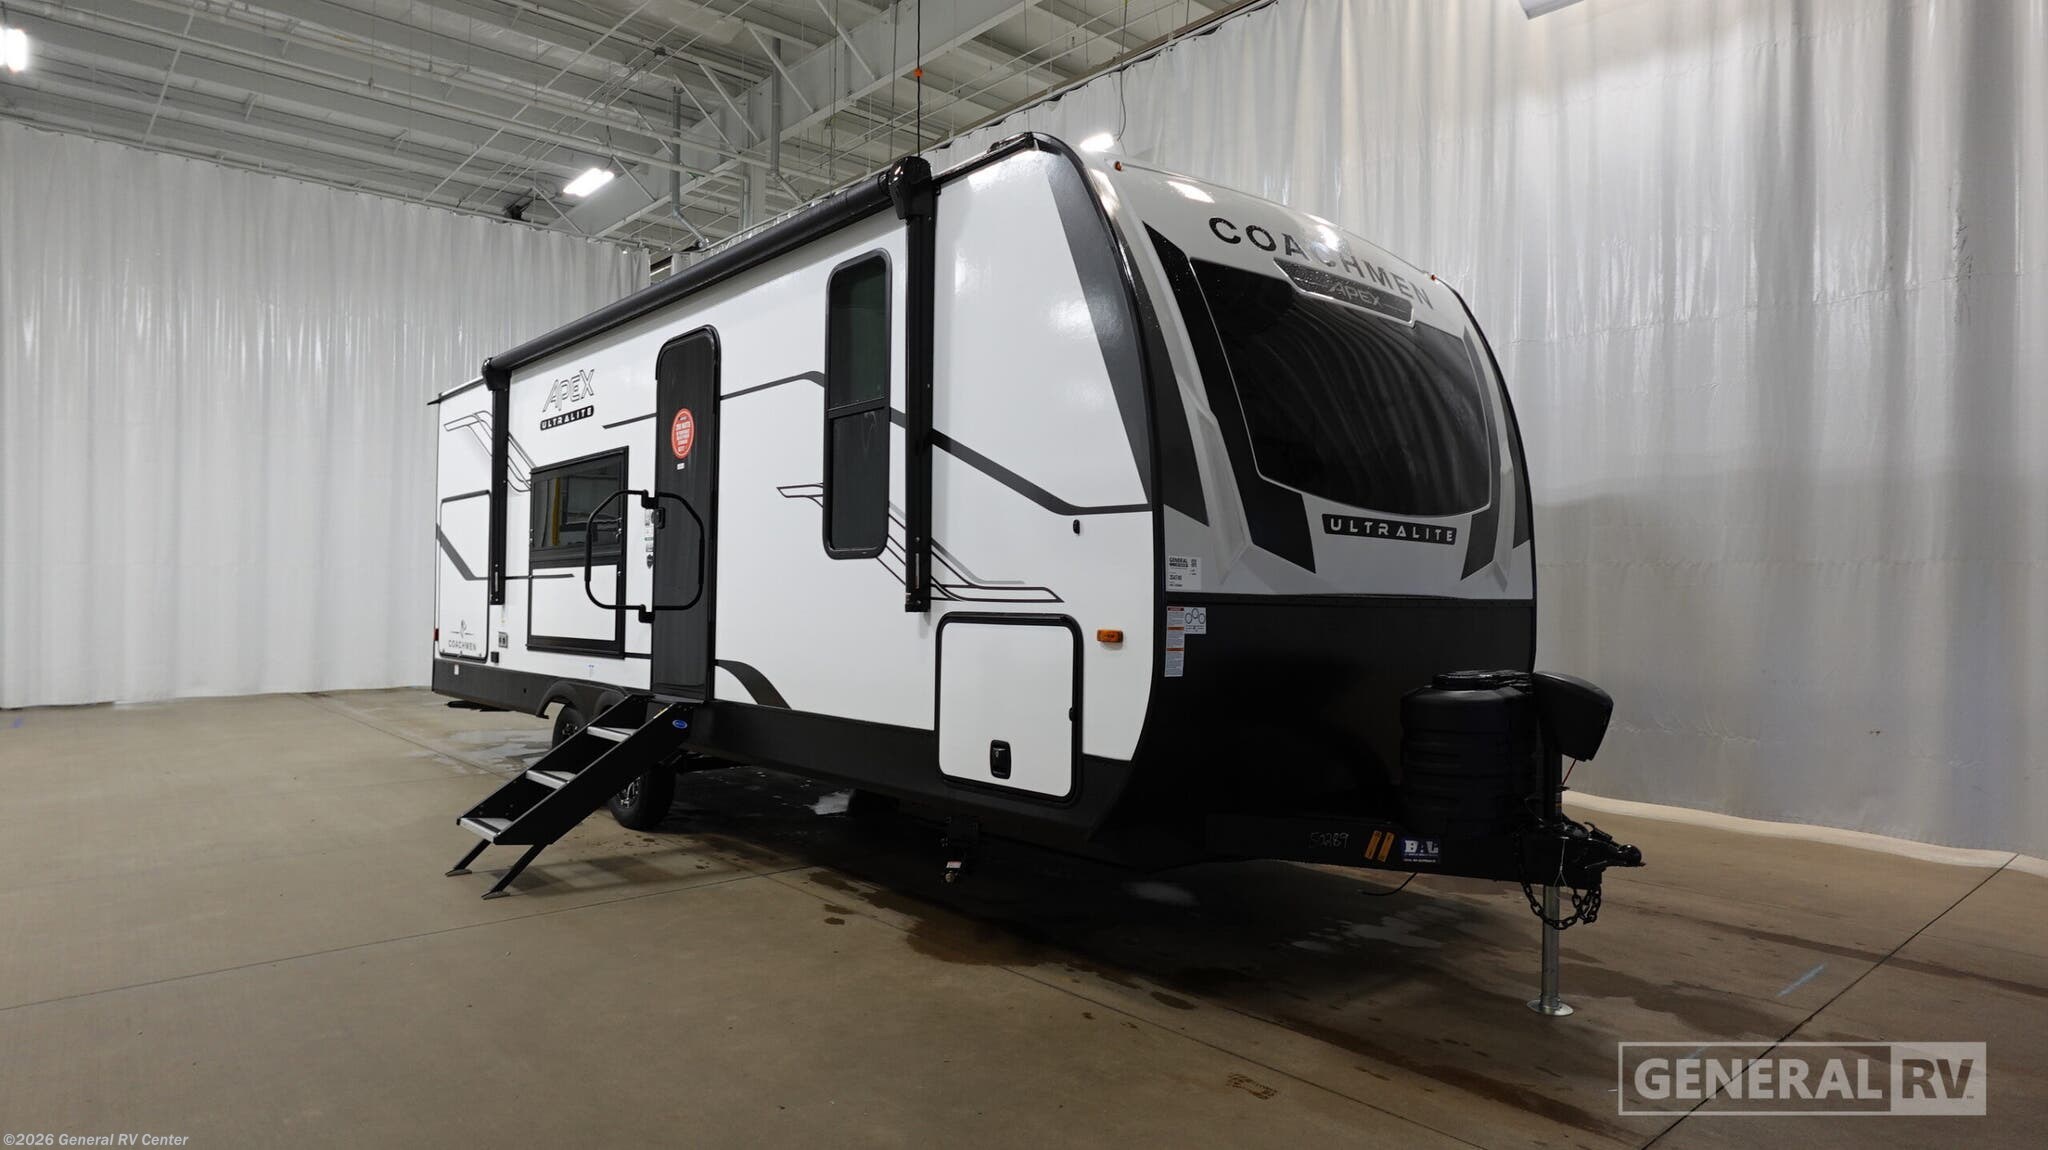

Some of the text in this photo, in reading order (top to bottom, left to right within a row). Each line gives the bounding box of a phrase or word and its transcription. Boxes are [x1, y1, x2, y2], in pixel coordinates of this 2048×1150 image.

[1208, 216, 1435, 310] COACHMEN
[1327, 281, 1385, 307] APEX
[541, 368, 595, 413] APEX
[541, 407, 594, 429] ULTRALITE
[1329, 517, 1455, 543] ULTRALITE
[447, 639, 477, 652] COACHMEN
